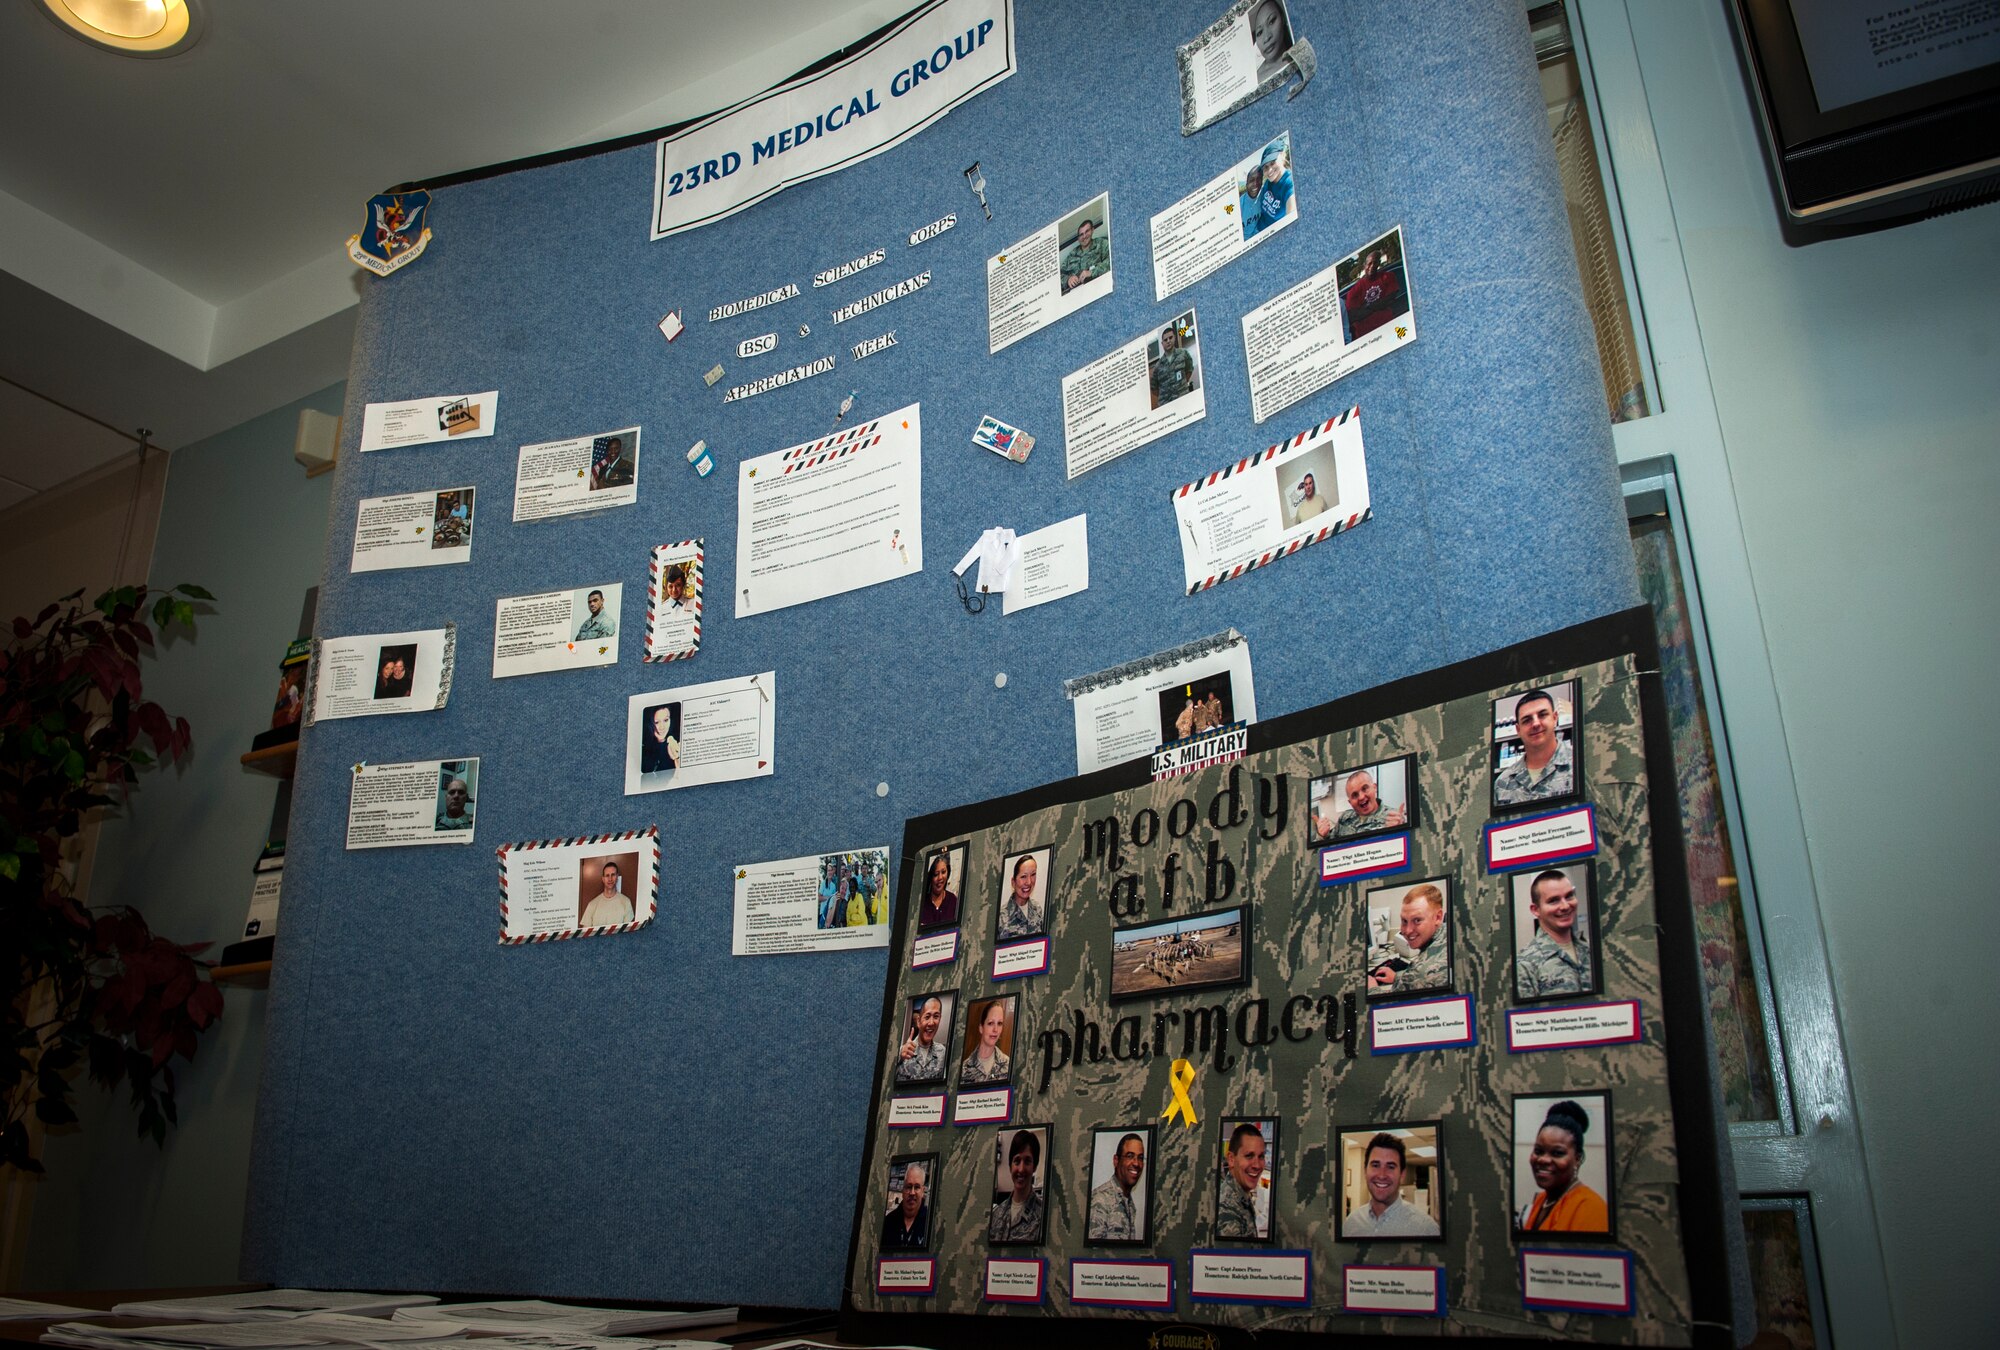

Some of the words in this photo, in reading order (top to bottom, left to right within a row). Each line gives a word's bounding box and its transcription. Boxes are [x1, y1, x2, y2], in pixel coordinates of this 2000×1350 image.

[668, 151, 741, 197] 23RD
[752, 88, 882, 166] MEDICAL
[890, 18, 993, 98] GROUP
[709, 284, 798, 320] BIOMEDICAL
[814, 249, 885, 287] SCIENCES
[908, 214, 956, 246] CORPS
[736, 333, 778, 357] (BSC)
[833, 271, 931, 324] TECHNICIANS
[725, 356, 836, 402] APPRECIATION
[852, 331, 897, 360] WEEK
[1151, 752, 1176, 773] U.S.
[1180, 731, 1246, 763] MILITARY
[1083, 764, 1289, 872] moody
[1037, 992, 1358, 1095] pharmacy
[1162, 1334, 1205, 1350] COURAGE
